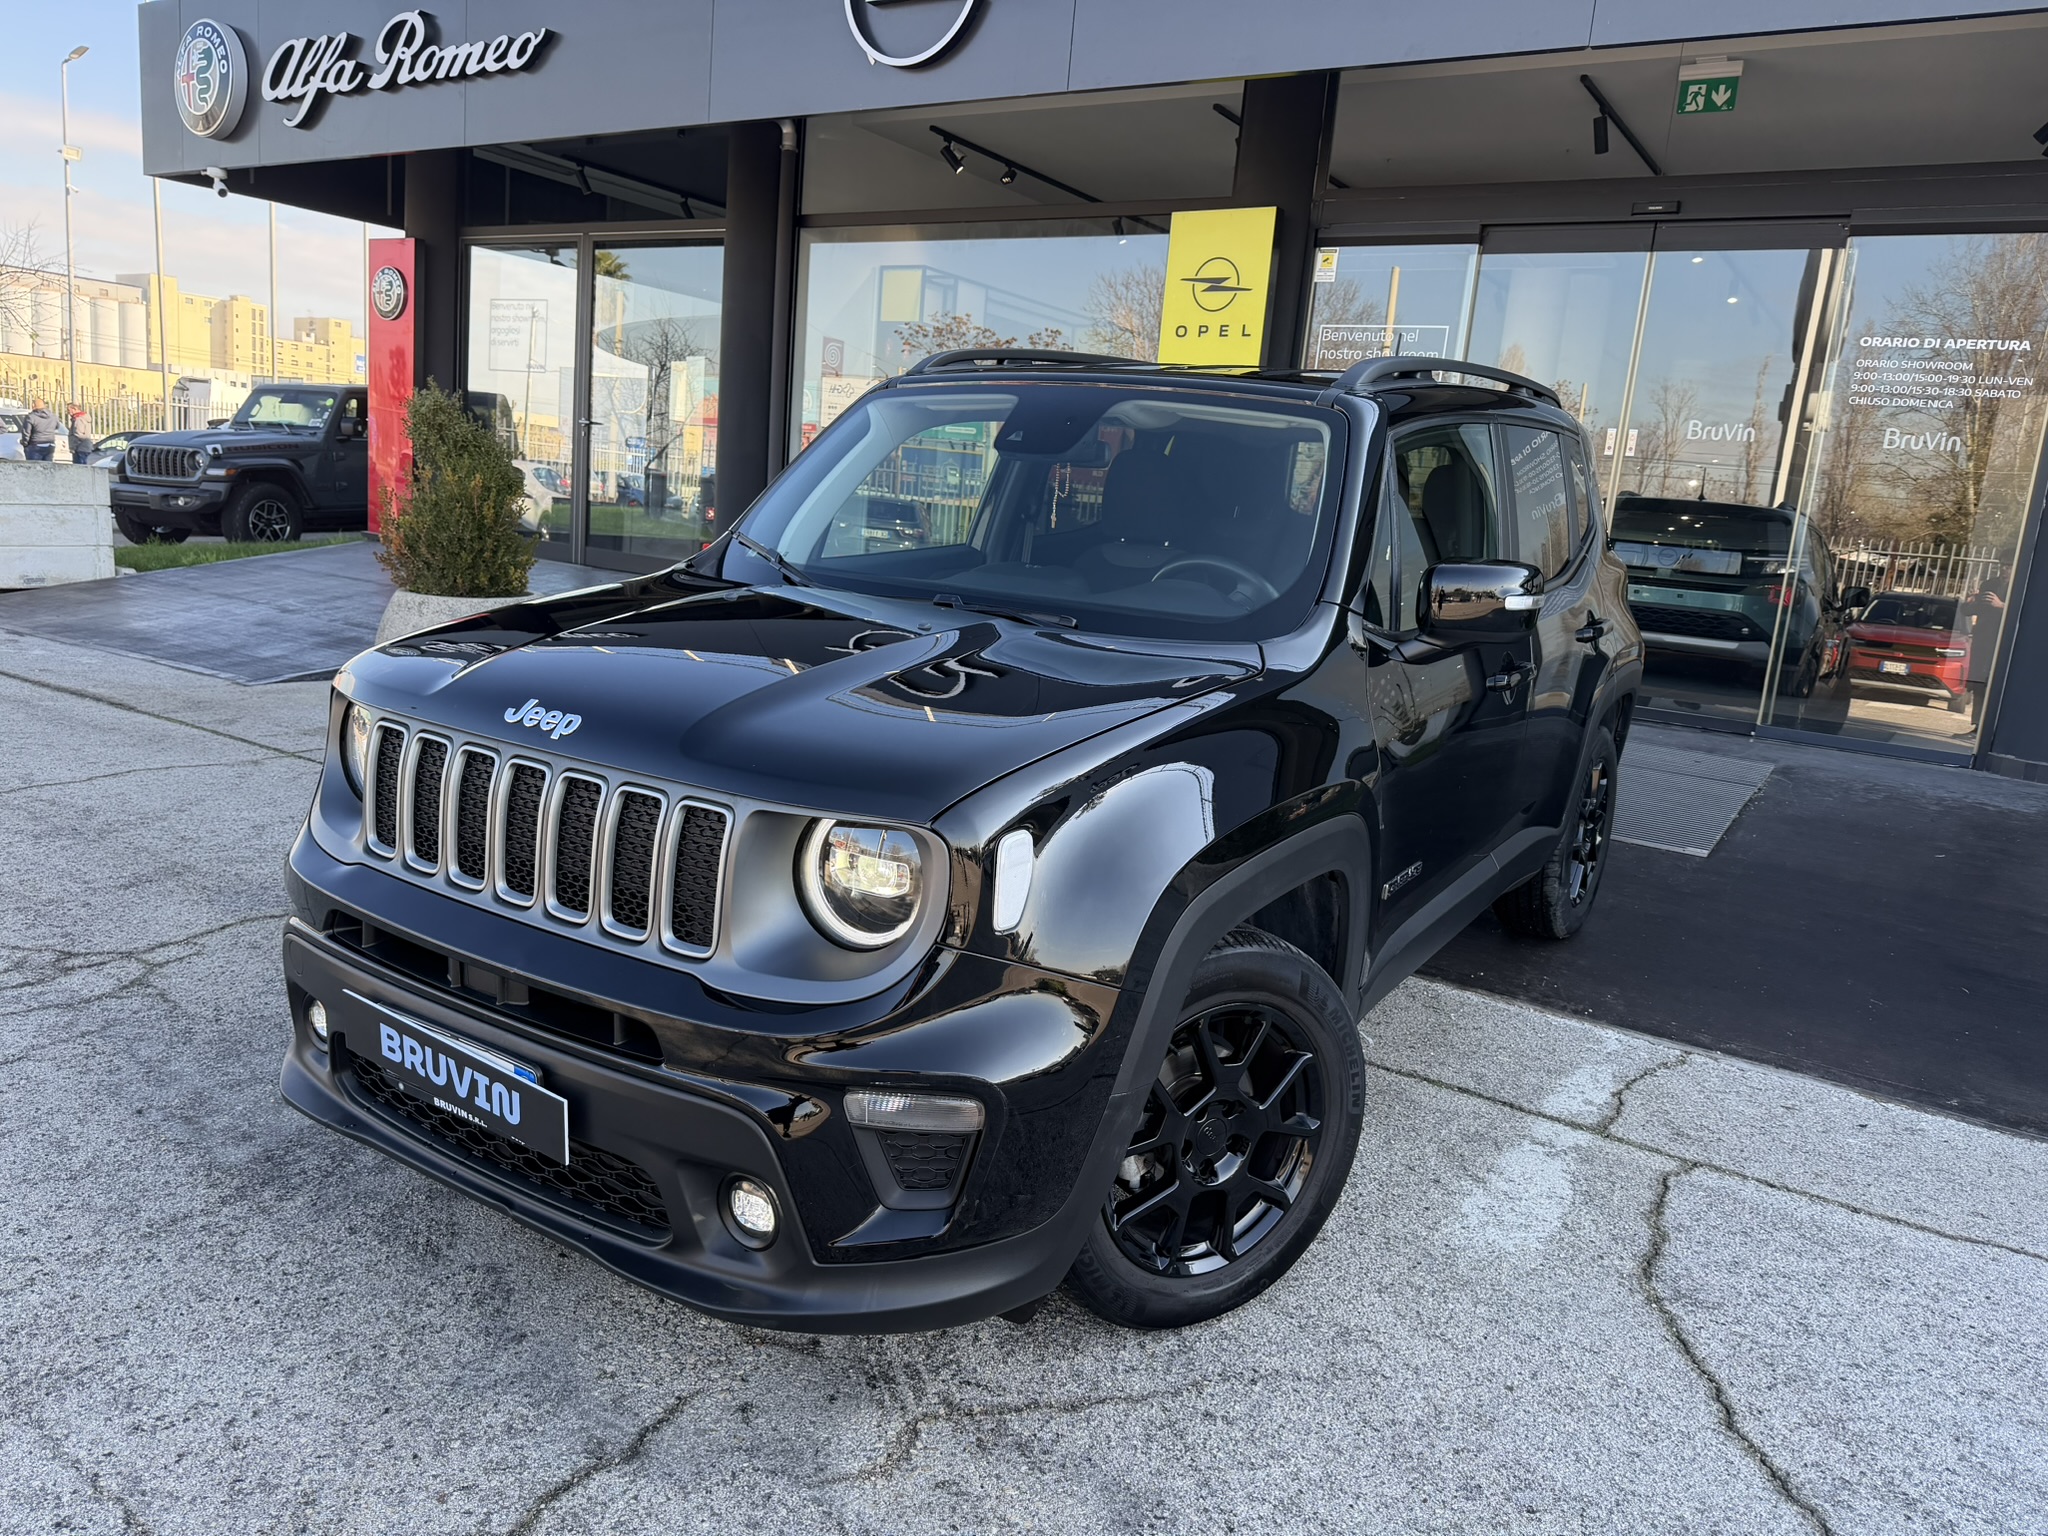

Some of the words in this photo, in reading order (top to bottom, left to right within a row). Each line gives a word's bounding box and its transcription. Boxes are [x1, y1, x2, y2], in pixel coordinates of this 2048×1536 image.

[196, 25, 228, 74] ROMEO
[261, 31, 365, 128] Alfa
[367, 9, 546, 91] Romeo
[1175, 324, 1252, 338] OPEL
[1321, 328, 1395, 342] Benvenuto
[1859, 336, 1920, 349] ORARIO
[1923, 338, 1940, 349] DI
[1943, 338, 2032, 351] APERTURA
[1319, 347, 1363, 361] nostro
[1855, 358, 1899, 369] ORARIO
[1900, 360, 1974, 371] SHOWROOM
[1978, 376, 2034, 386] LUN-VEN
[1848, 396, 1890, 407] CHIUSO
[1891, 398, 1954, 409] DOMENICA
[1974, 389, 2022, 399] SABATO
[1686, 419, 1756, 443] BruVin
[1882, 427, 1961, 452] BruVin
[503, 698, 583, 741] Jeep
[1327, 1006, 1361, 1108] MICHELIN
[379, 1022, 521, 1126] BRUVIN
[433, 1096, 468, 1120] BRUVIN
[468, 1113, 488, 1129] S.R.L.
